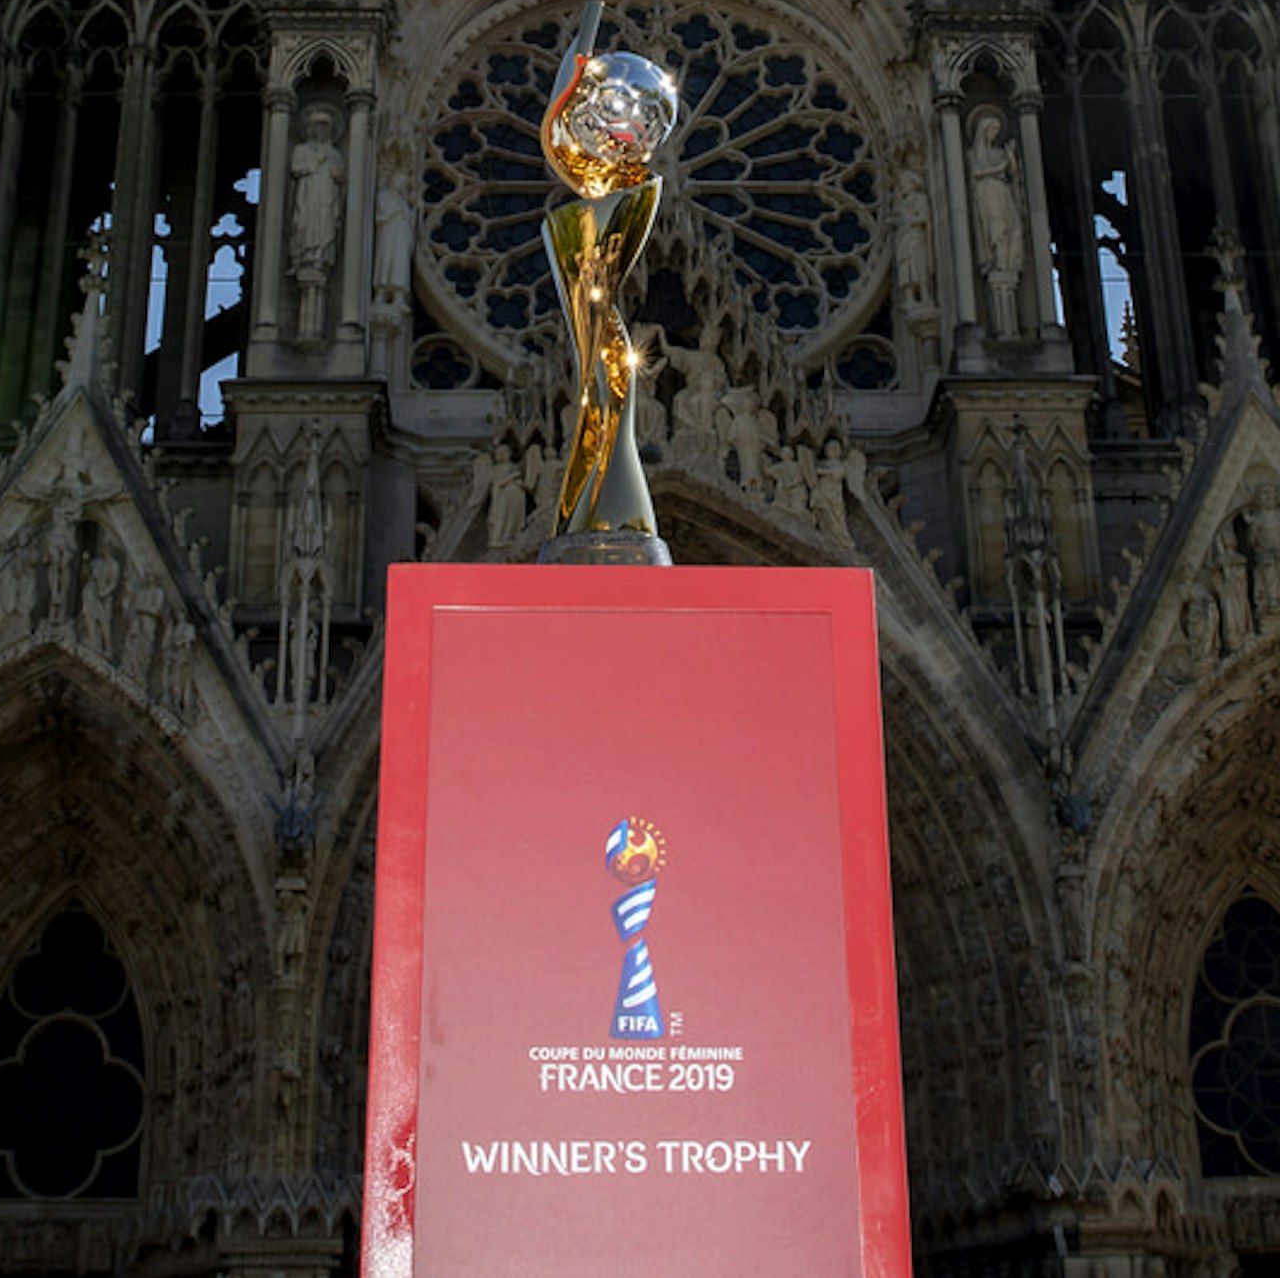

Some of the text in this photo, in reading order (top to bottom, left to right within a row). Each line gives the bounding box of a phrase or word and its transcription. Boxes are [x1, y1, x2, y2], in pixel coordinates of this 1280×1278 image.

[618, 1016, 658, 1032] FIFA
[529, 1045, 743, 1060] COUPE DU MONDE FÉMININE
[540, 1063, 734, 1093] FRANCE 2019
[462, 1140, 811, 1175] WINNER'S TROPHY
